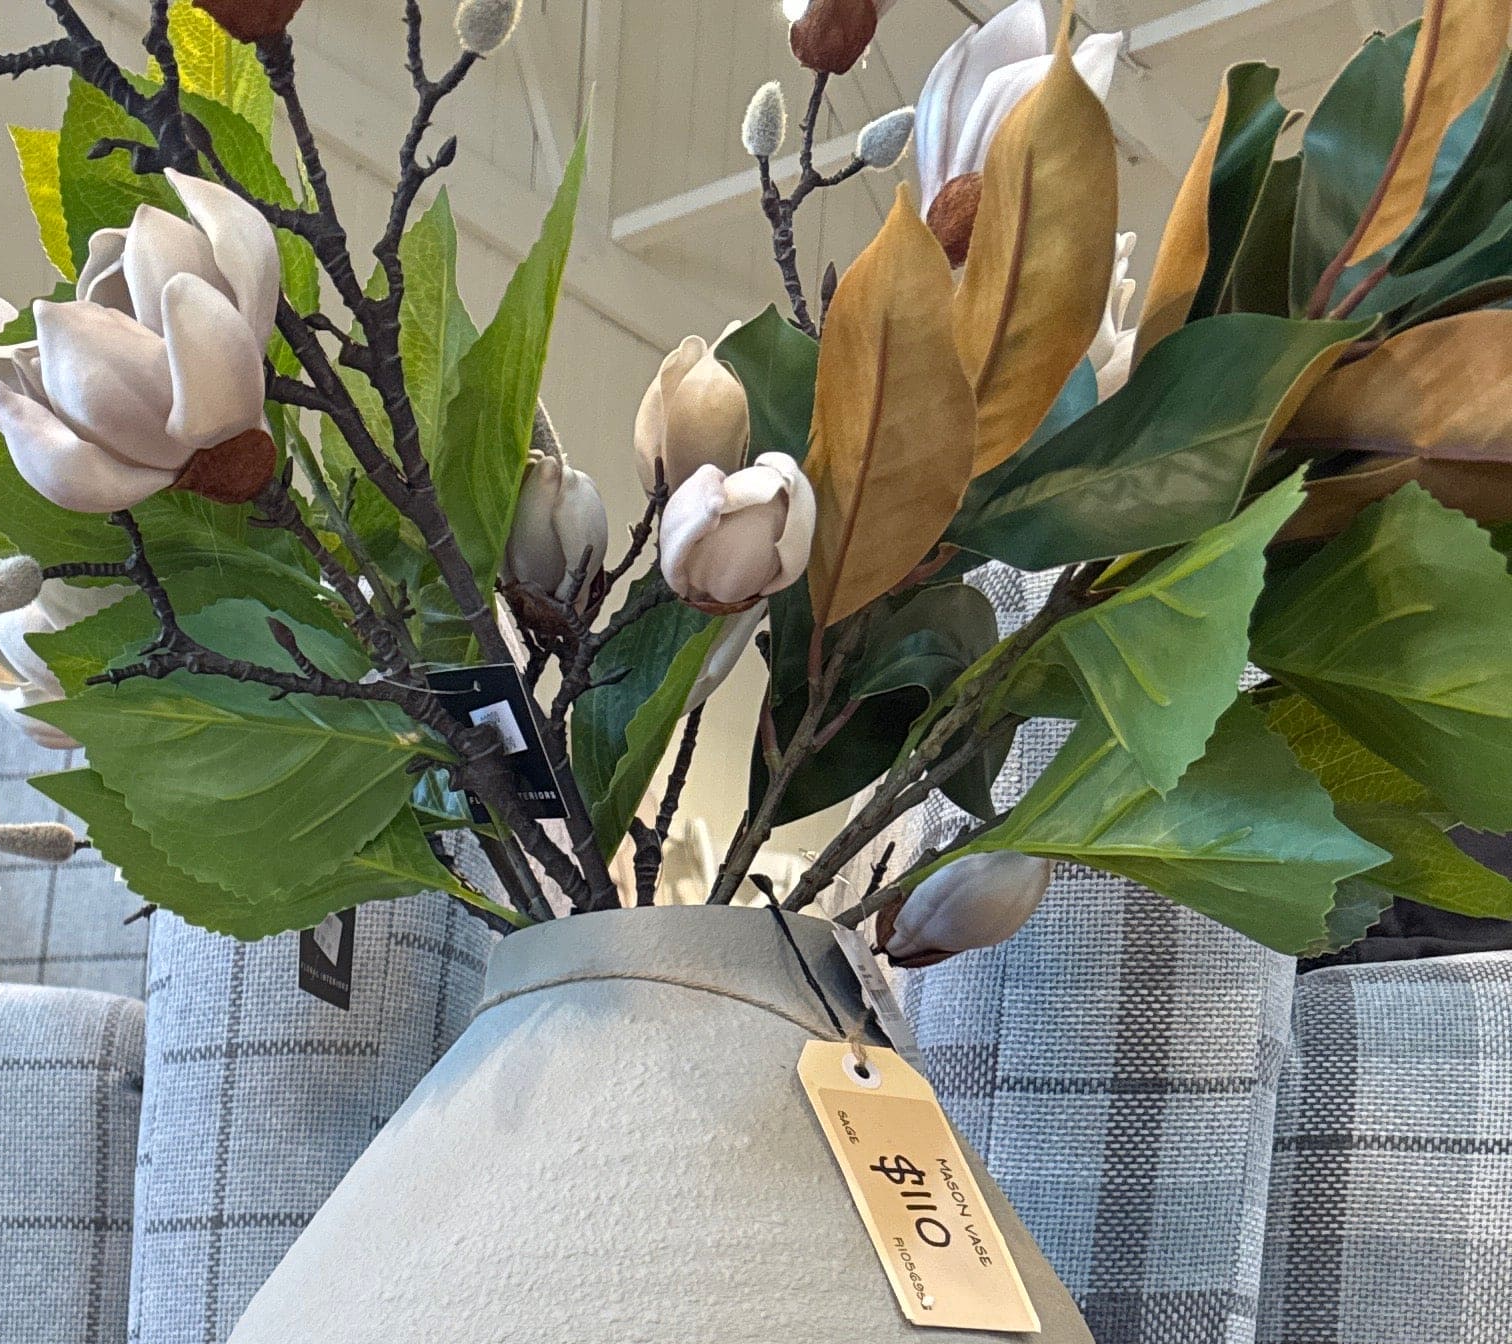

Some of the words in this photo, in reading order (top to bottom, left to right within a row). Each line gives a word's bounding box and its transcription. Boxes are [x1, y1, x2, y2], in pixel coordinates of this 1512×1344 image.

[837, 1110, 860, 1145] SAGE
[869, 1154, 952, 1248] $110
[935, 1158, 973, 1218] MASON
[964, 1224, 993, 1268] VASE
